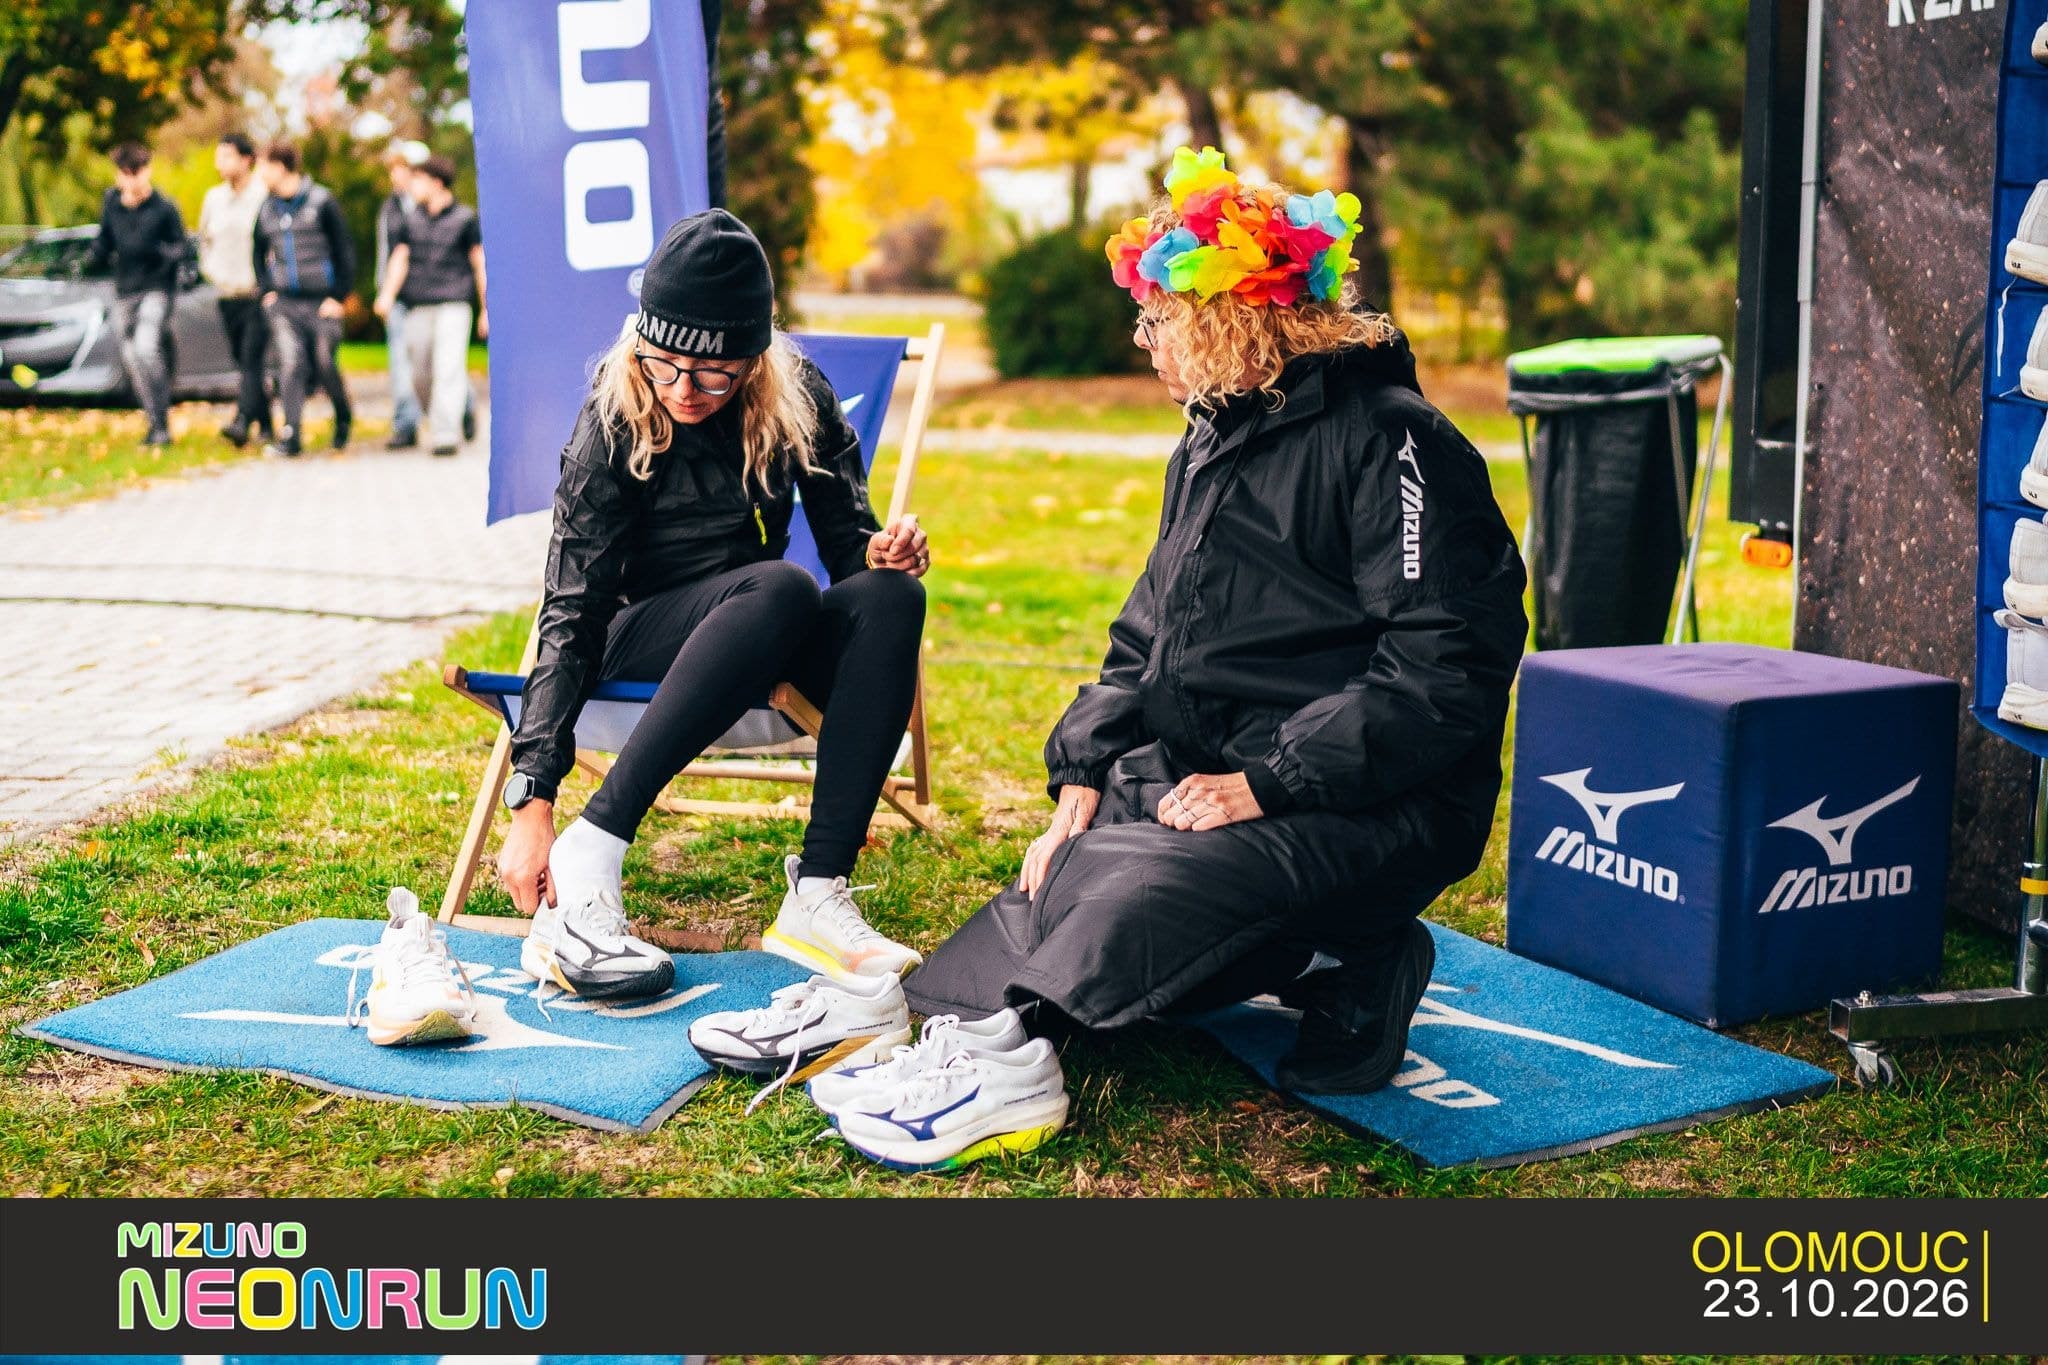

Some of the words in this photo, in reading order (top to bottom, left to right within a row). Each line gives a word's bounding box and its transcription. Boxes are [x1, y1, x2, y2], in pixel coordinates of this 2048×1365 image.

[1399, 474, 1424, 580] MIZUNO
[1534, 826, 1679, 902] MIZUNO
[1758, 864, 1912, 914] MIZUNO
